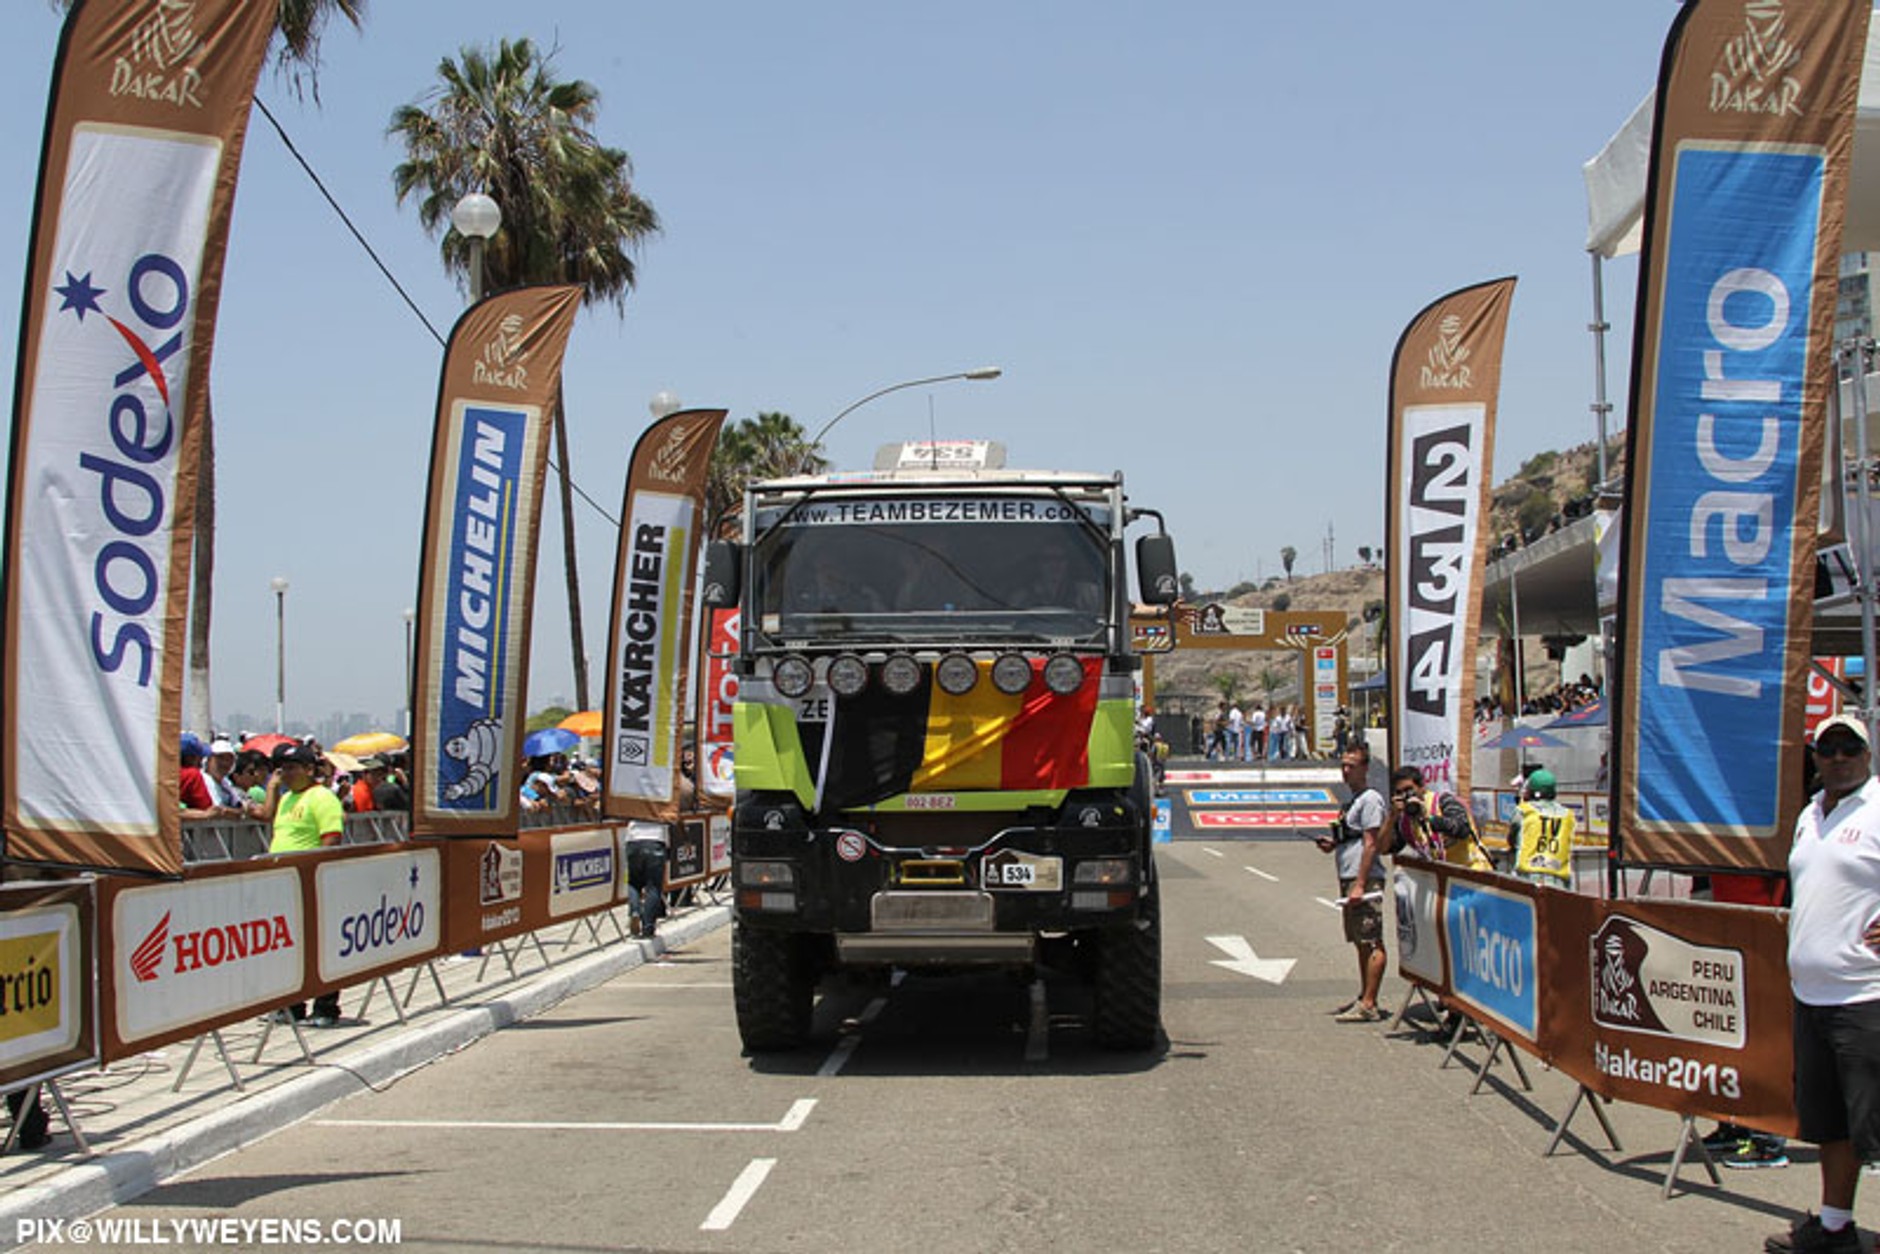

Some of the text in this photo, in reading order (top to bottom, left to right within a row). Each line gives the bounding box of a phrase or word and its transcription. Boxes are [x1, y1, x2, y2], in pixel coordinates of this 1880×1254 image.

[110, 57, 203, 107] DAKAR
[1709, 72, 1803, 117] DAKAR
[473, 363, 528, 389] DAKAR
[1420, 365, 1472, 389] DAKAR
[80, 253, 188, 687] sodexo
[1659, 267, 1790, 698] Macro
[776, 502, 1093, 522] ww.TEAMBEZEMER.com
[455, 421, 505, 708] MICHELIN
[621, 523, 667, 731] KÄRCHER
[712, 611, 741, 735] TOTA
[1210, 791, 1313, 801] Macro
[1539, 816, 1562, 837] TV
[1006, 865, 1031, 882] 534
[173, 915, 294, 974] HONDA
[339, 894, 425, 957] sodexo
[1459, 905, 1523, 997] Macro
[1692, 960, 1735, 982] PERU
[1649, 979, 1736, 1009] ARGENTINA
[1692, 1010, 1737, 1034] CHILE
